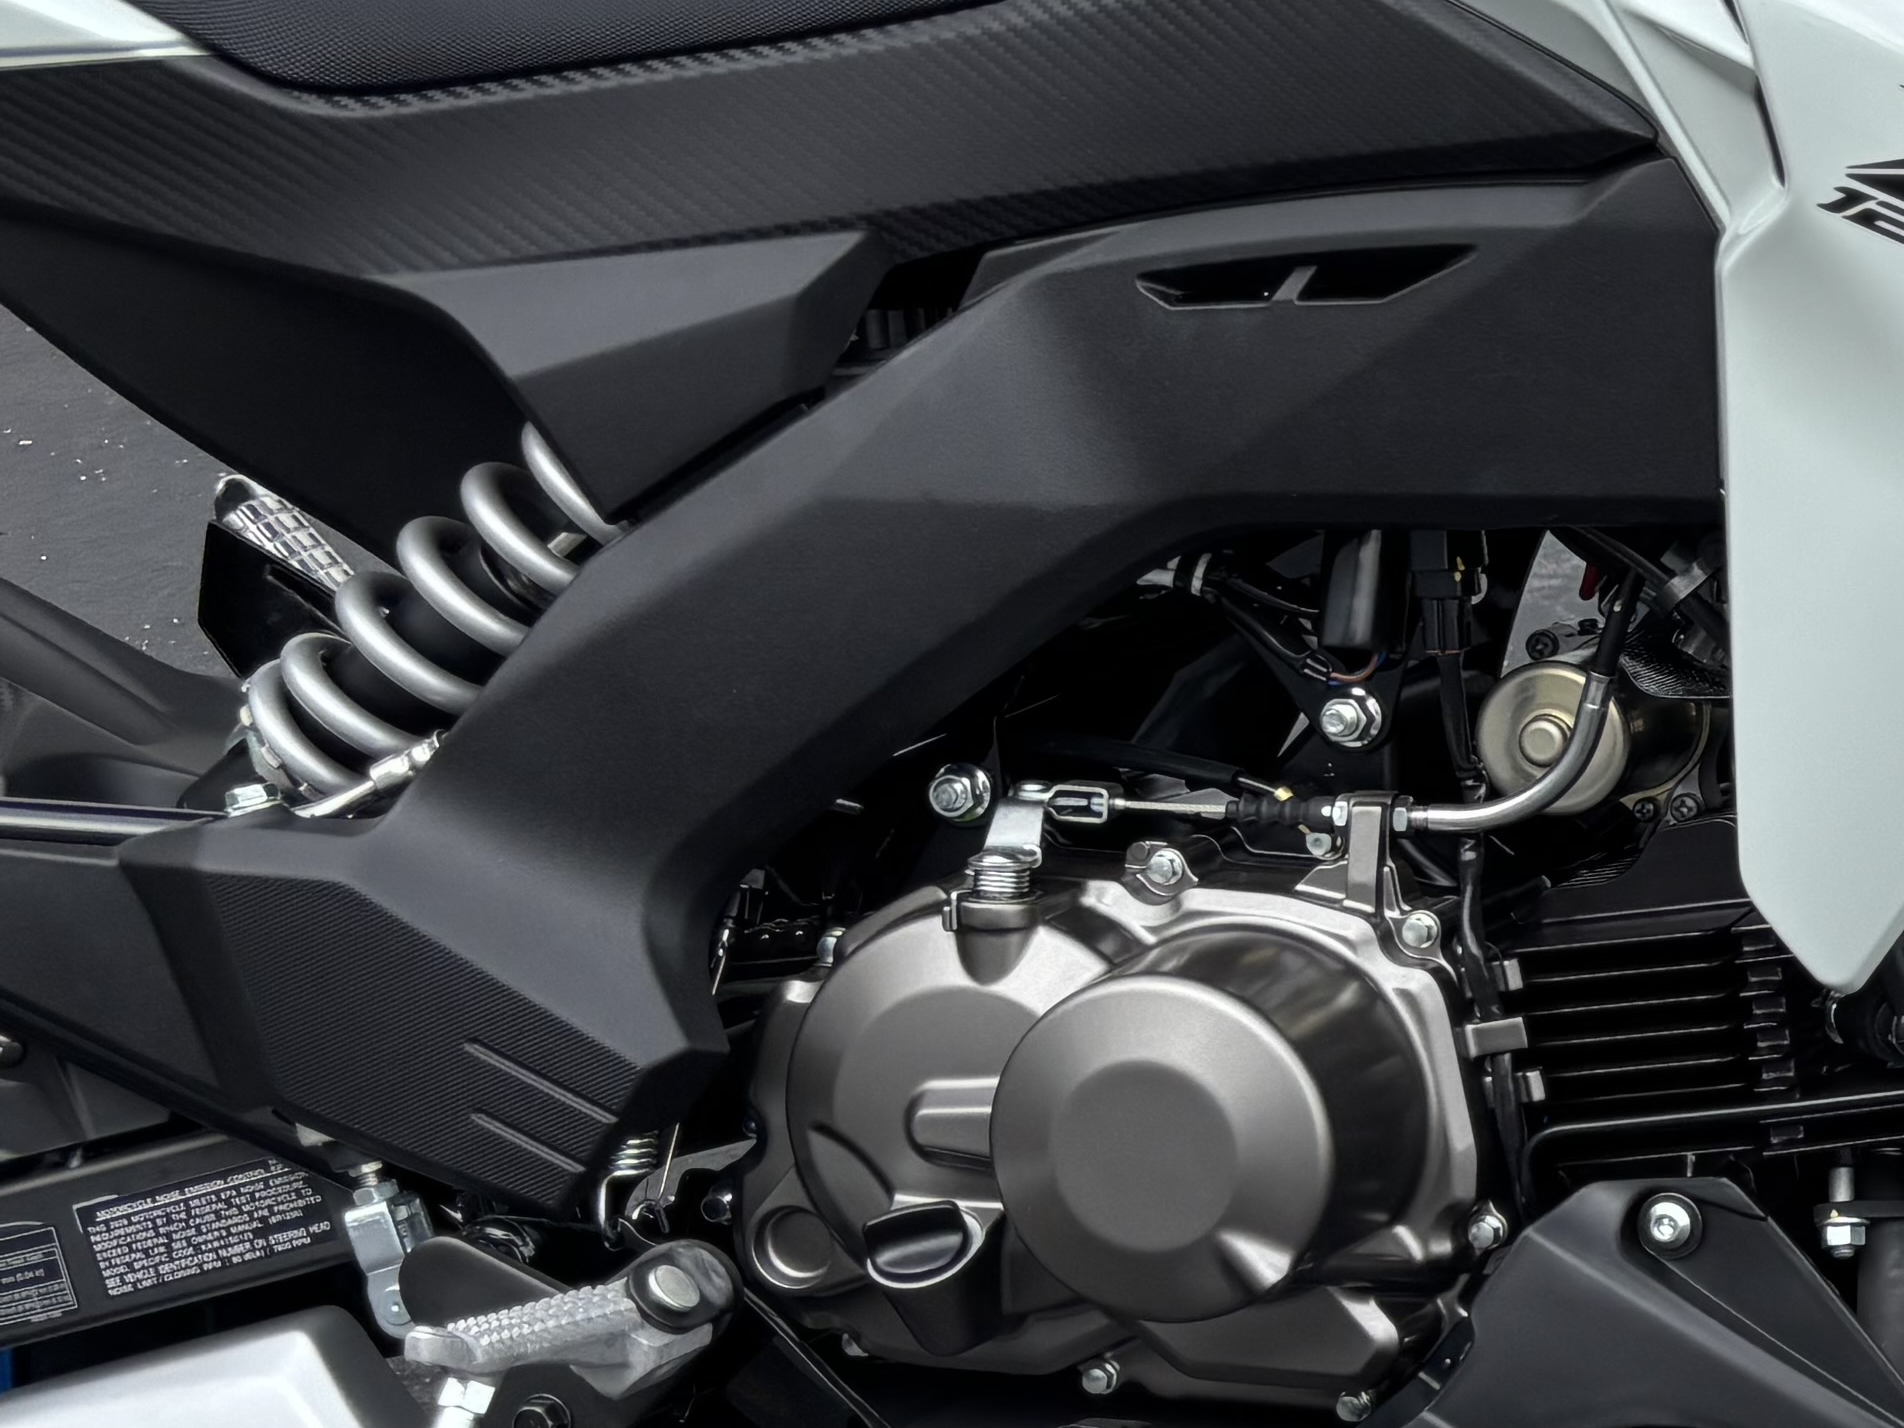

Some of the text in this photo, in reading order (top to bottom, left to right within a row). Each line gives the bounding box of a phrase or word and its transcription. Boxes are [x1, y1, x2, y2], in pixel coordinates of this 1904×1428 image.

[226, 1167, 265, 1183] CONTROL
[87, 1223, 106, 1234] THIS
[130, 1202, 186, 1223] MOTORCYCLE
[188, 1194, 217, 1207] MEETS
[239, 1181, 264, 1193] NOISE
[89, 1220, 153, 1243] REQUIREMENTS
[171, 1211, 187, 1221] THE
[190, 1200, 227, 1216] FEDERAL
[230, 1194, 251, 1205] TEST
[92, 1187, 312, 1252] MODIFICATIONS WHICH CAUSE THIS MOTORCYCLE TO
[95, 1194, 322, 1261] EXCEED FEDERAL NOISE STANDARDS ARE PROHIBITED
[105, 1275, 122, 1288] SEE
[123, 1267, 156, 1283] VEHICLE
[157, 1250, 217, 1274] IDENTIFICATION
[218, 1241, 253, 1258] NUMBER
[268, 1227, 306, 1244] STEERING
[308, 1220, 331, 1234] HEAD
[110, 1250, 145, 1266] FEDERAL
[171, 1239, 186, 1249] SEE
[132, 1253, 169, 1269] SPECIFIC
